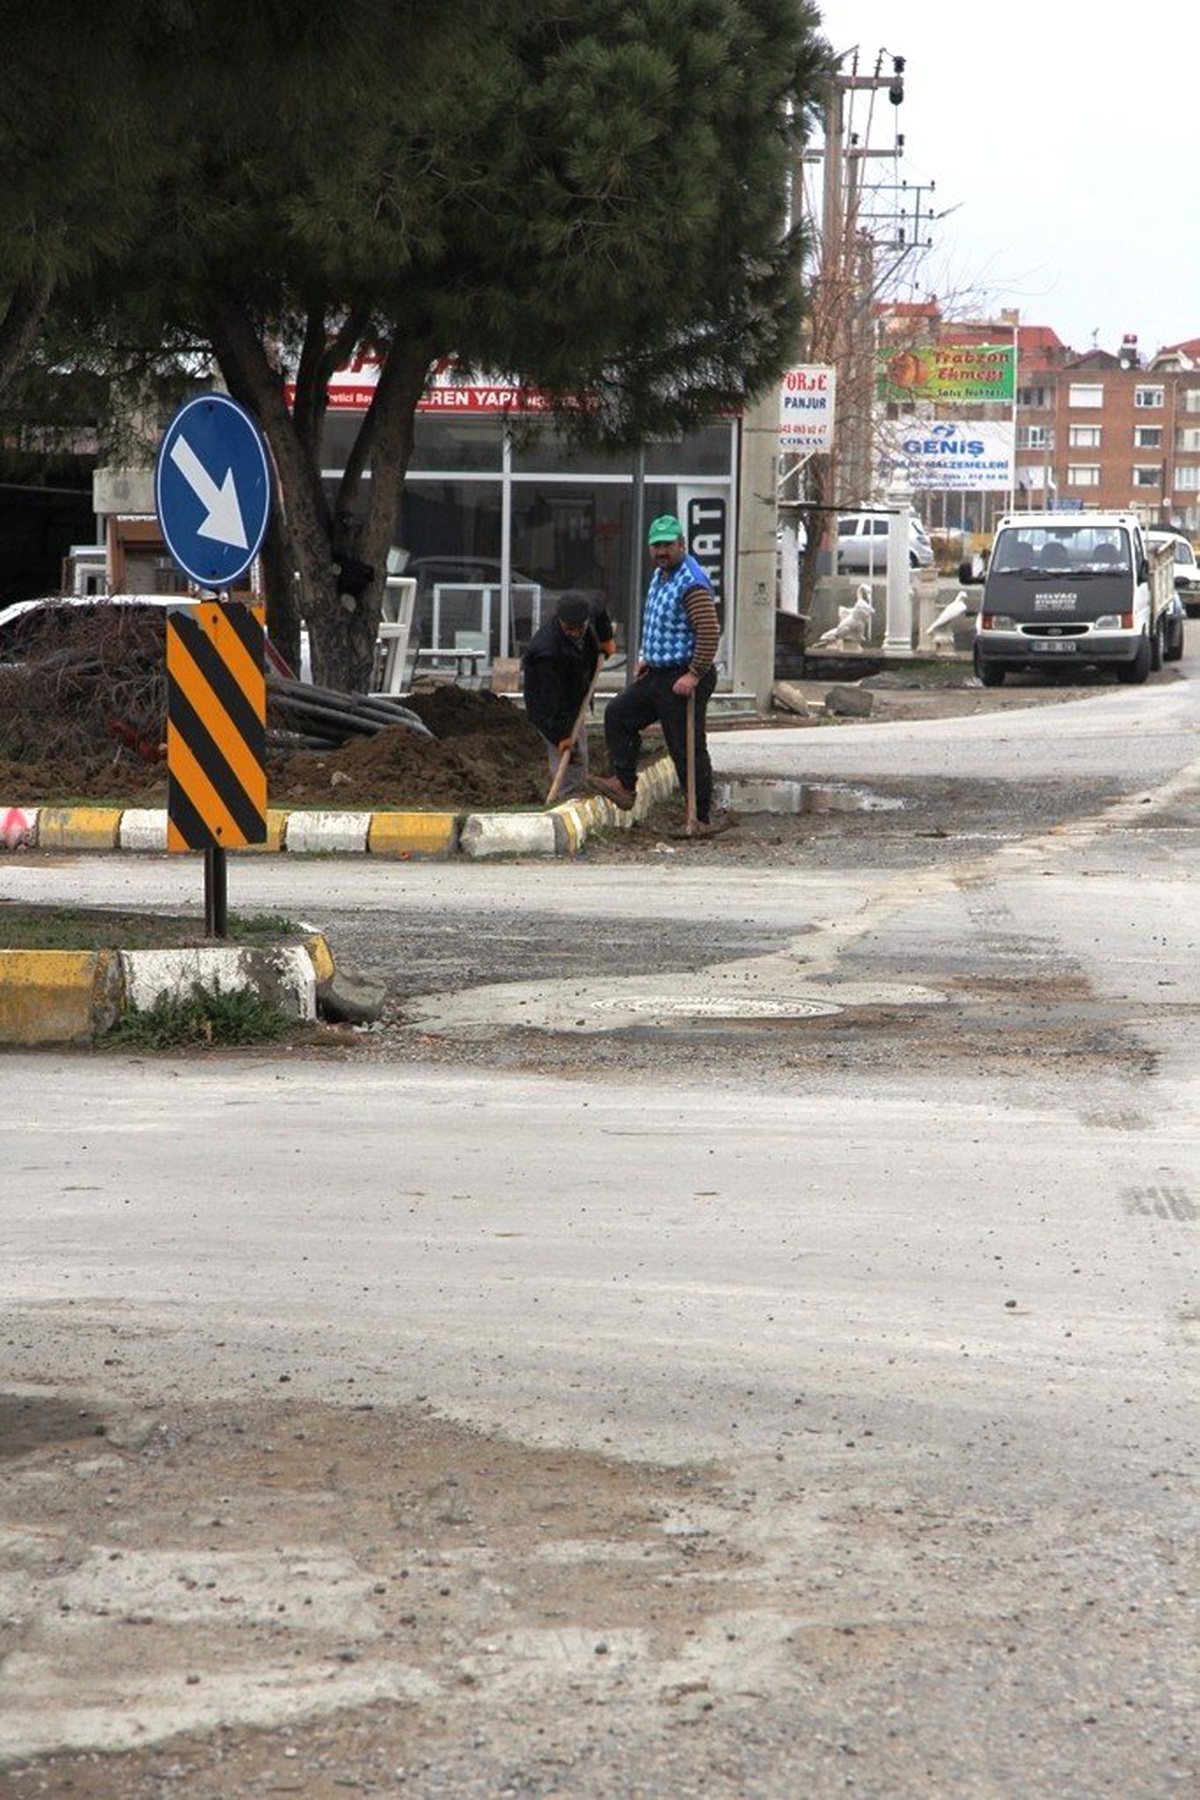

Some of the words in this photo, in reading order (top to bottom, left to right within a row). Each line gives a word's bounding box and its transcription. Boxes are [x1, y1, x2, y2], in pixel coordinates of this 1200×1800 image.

[935, 350, 1009, 364] Trabzon
[784, 397, 826, 409] PANJUR
[925, 460, 1009, 470] MALZEMELERİ
